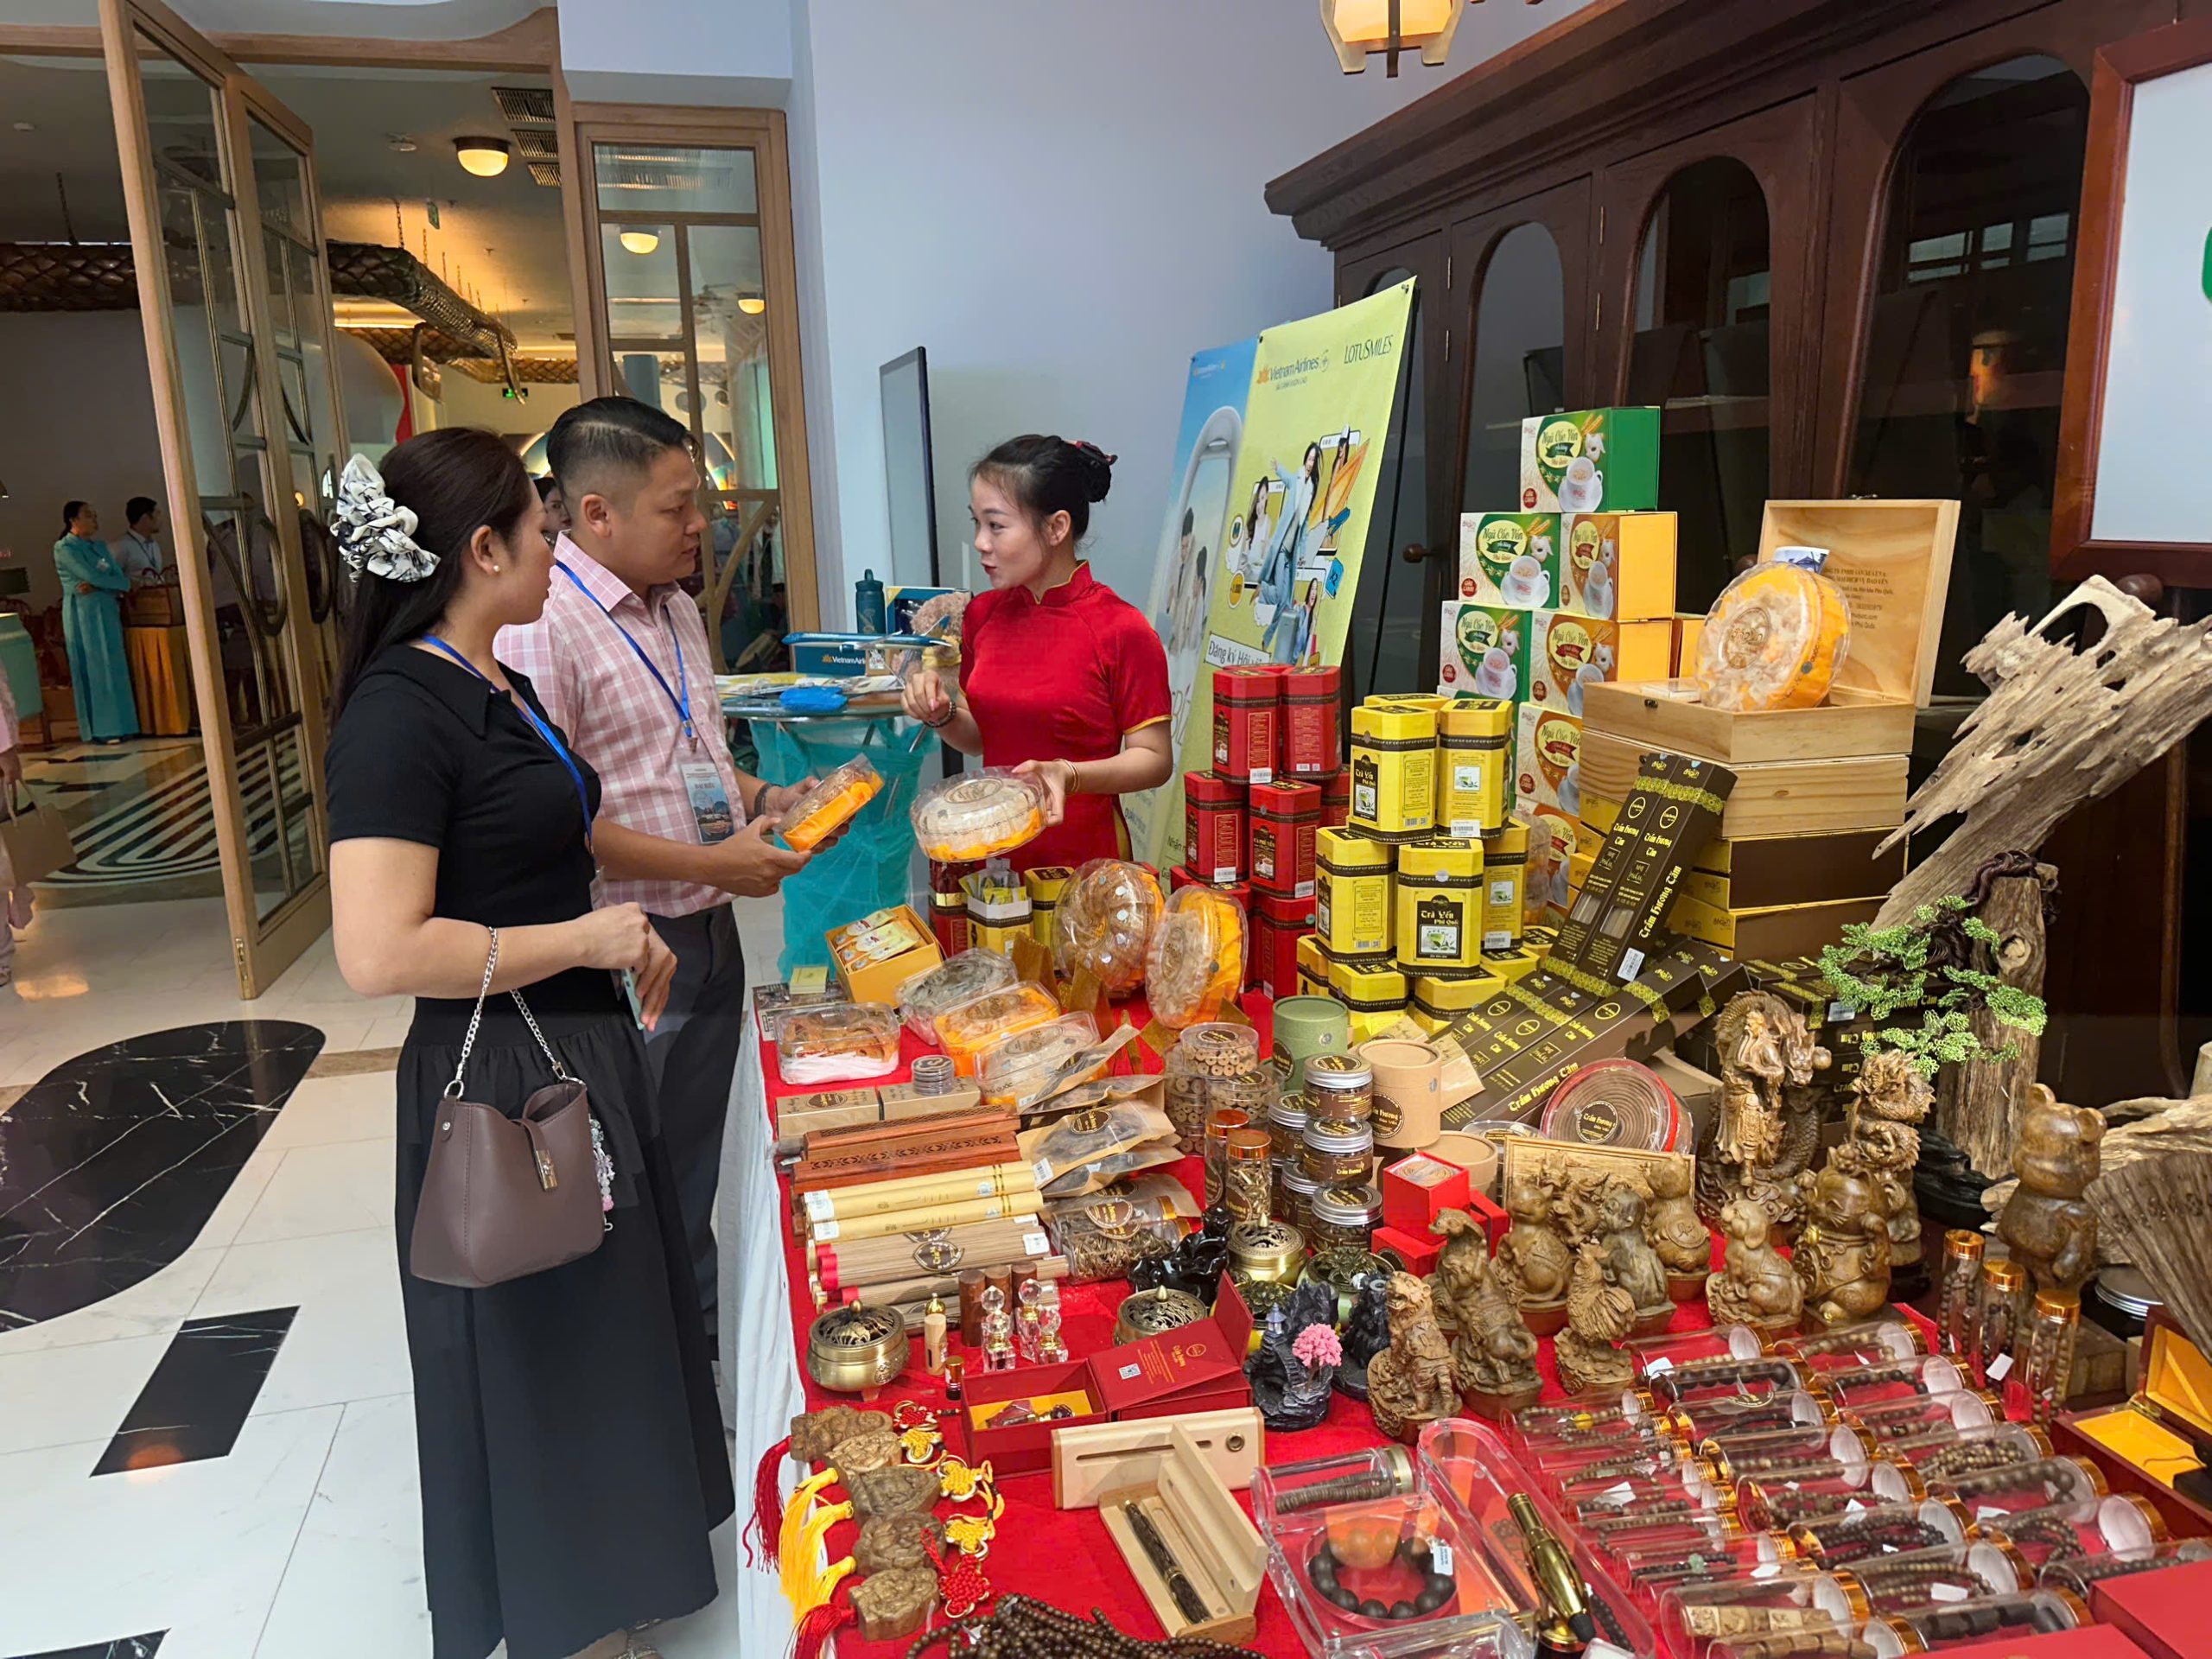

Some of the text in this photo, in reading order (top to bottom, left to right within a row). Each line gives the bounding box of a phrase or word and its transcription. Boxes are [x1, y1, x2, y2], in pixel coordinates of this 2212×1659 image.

[1270, 357, 1319, 381] Vietnam Airlines
[1210, 640, 1226, 664] Đăng
[1421, 910, 1454, 919] Trà Yến
[1638, 914, 1656, 938] Trầm
[1650, 886, 1673, 915] Hương
[1508, 1093, 1532, 1111] Trầm
[1530, 1075, 1560, 1097] Hương
